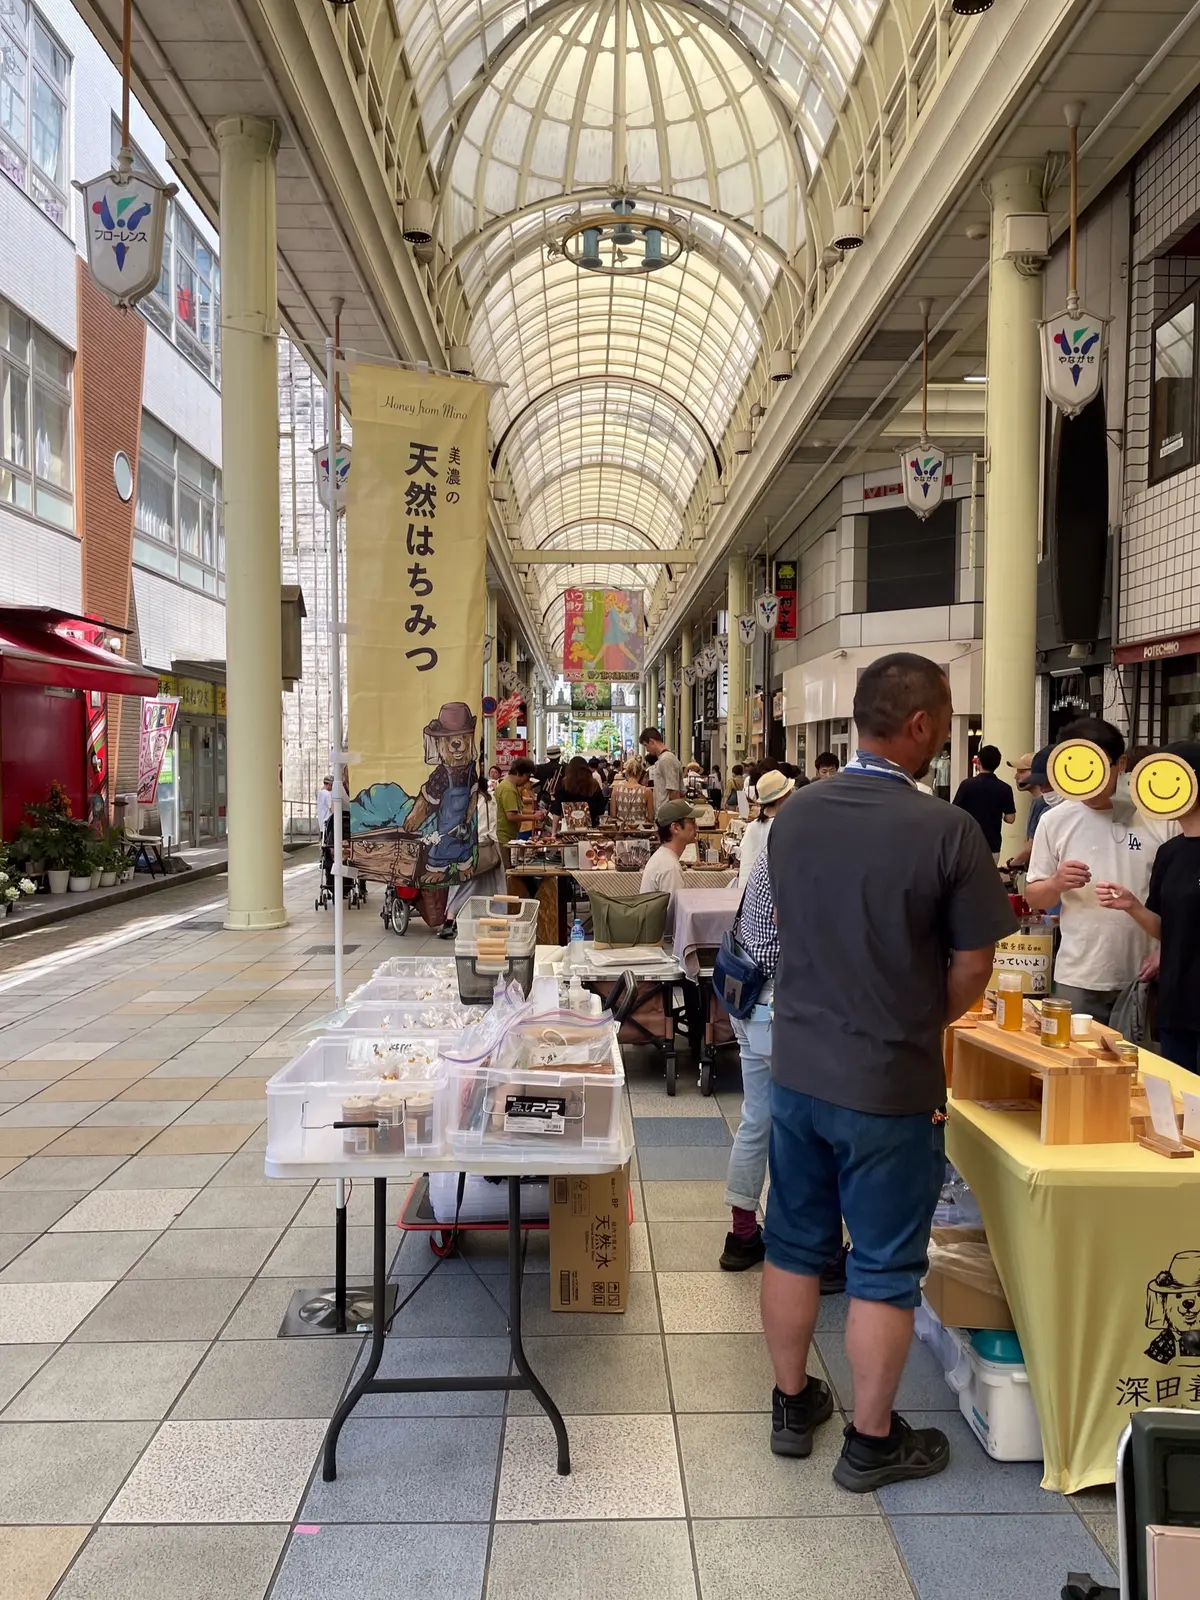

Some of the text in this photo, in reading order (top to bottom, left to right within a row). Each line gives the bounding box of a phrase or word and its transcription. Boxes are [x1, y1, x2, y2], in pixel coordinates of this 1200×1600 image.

[94, 229, 148, 243] フローレンス
[1059, 355, 1095, 365] やながせ
[379, 395, 468, 420] Honey from Mino
[445, 446, 462, 505] 美濃の
[404, 441, 439, 672] 天然はちみつ
[144, 704, 173, 730] OPEN
[1127, 833, 1142, 851] LA
[611, 1198, 619, 1208] BP
[595, 1214, 612, 1270] 天然水
